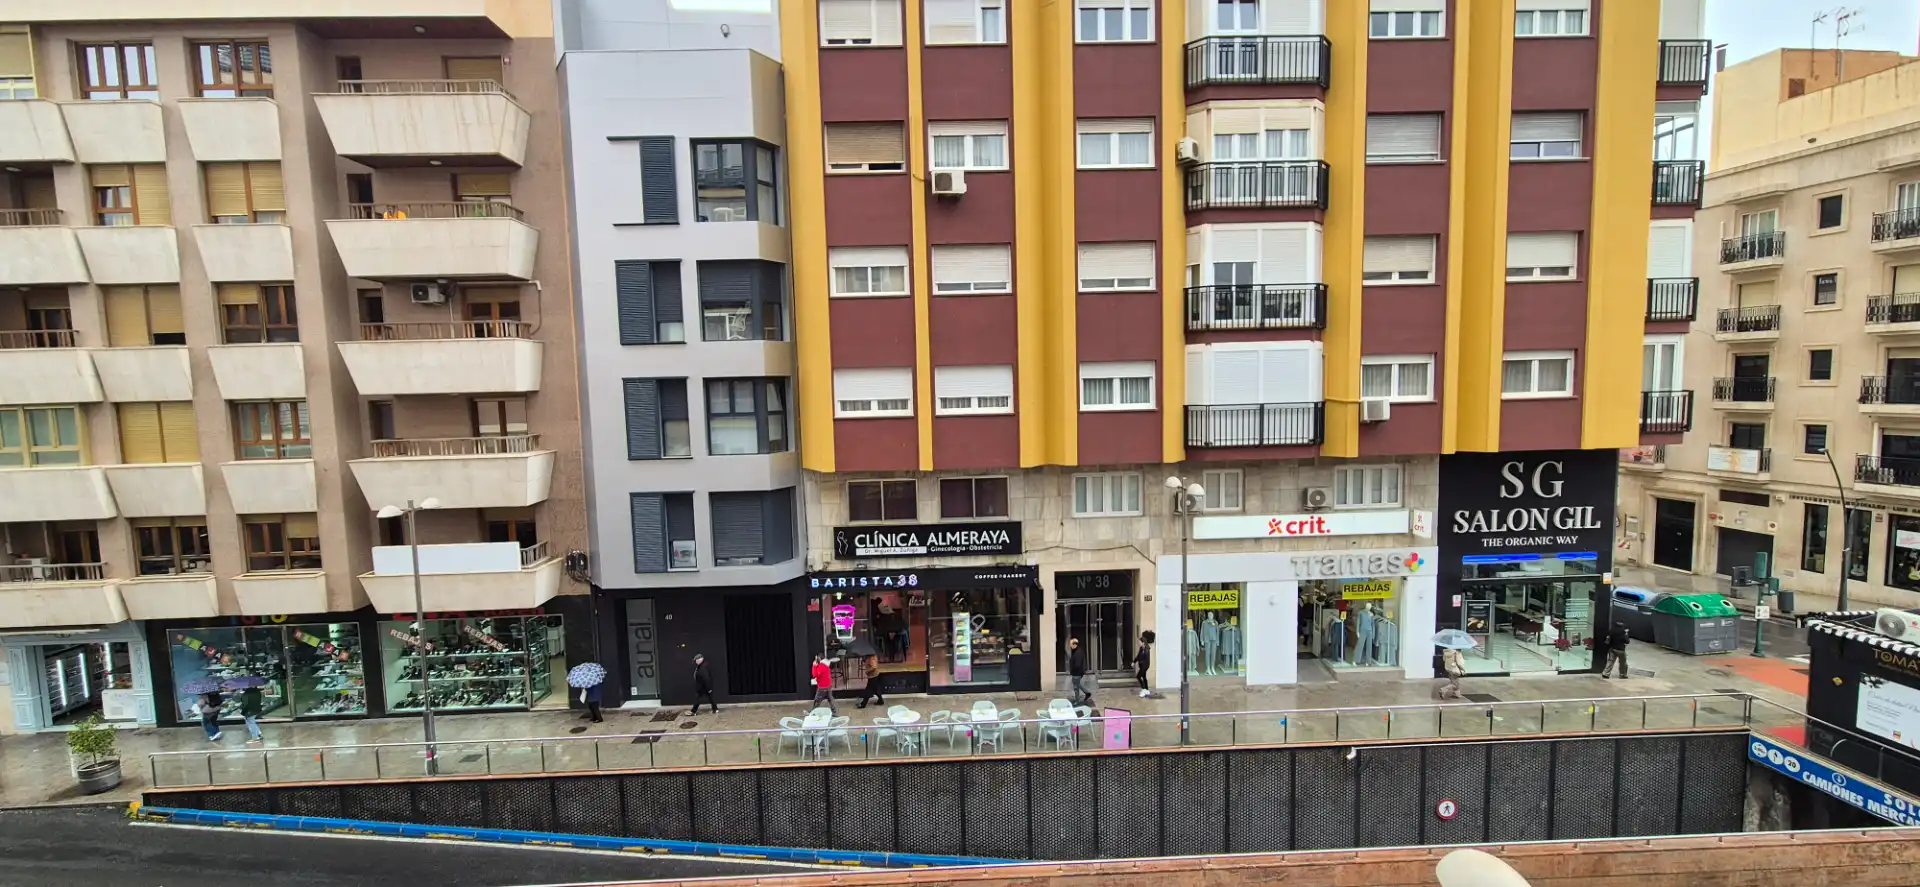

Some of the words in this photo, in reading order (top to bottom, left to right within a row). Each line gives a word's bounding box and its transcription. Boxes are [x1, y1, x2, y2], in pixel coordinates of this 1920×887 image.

[1285, 515, 1331, 535] crit.
[1452, 507, 1550, 534] SALON
[1553, 506, 1601, 530] GIL
[854, 530, 920, 548] CLÍNICA
[926, 529, 1011, 547] ALMERAYA
[969, 544, 1003, 552] Obstetricia
[1481, 537, 1504, 548] THE
[1505, 535, 1554, 547] ORGANIC
[1556, 535, 1579, 545] WAY
[1095, 574, 1110, 588] 38
[1344, 583, 1390, 593] REBAJAS
[1189, 593, 1237, 603] REBAJAS
[390, 628, 432, 650] REBAJS
[463, 624, 504, 651] REBAJAS
[1871, 647, 1920, 671] TOMA
[1802, 771, 1864, 807] CAMIONES
[1884, 792, 1920, 817] SOL
